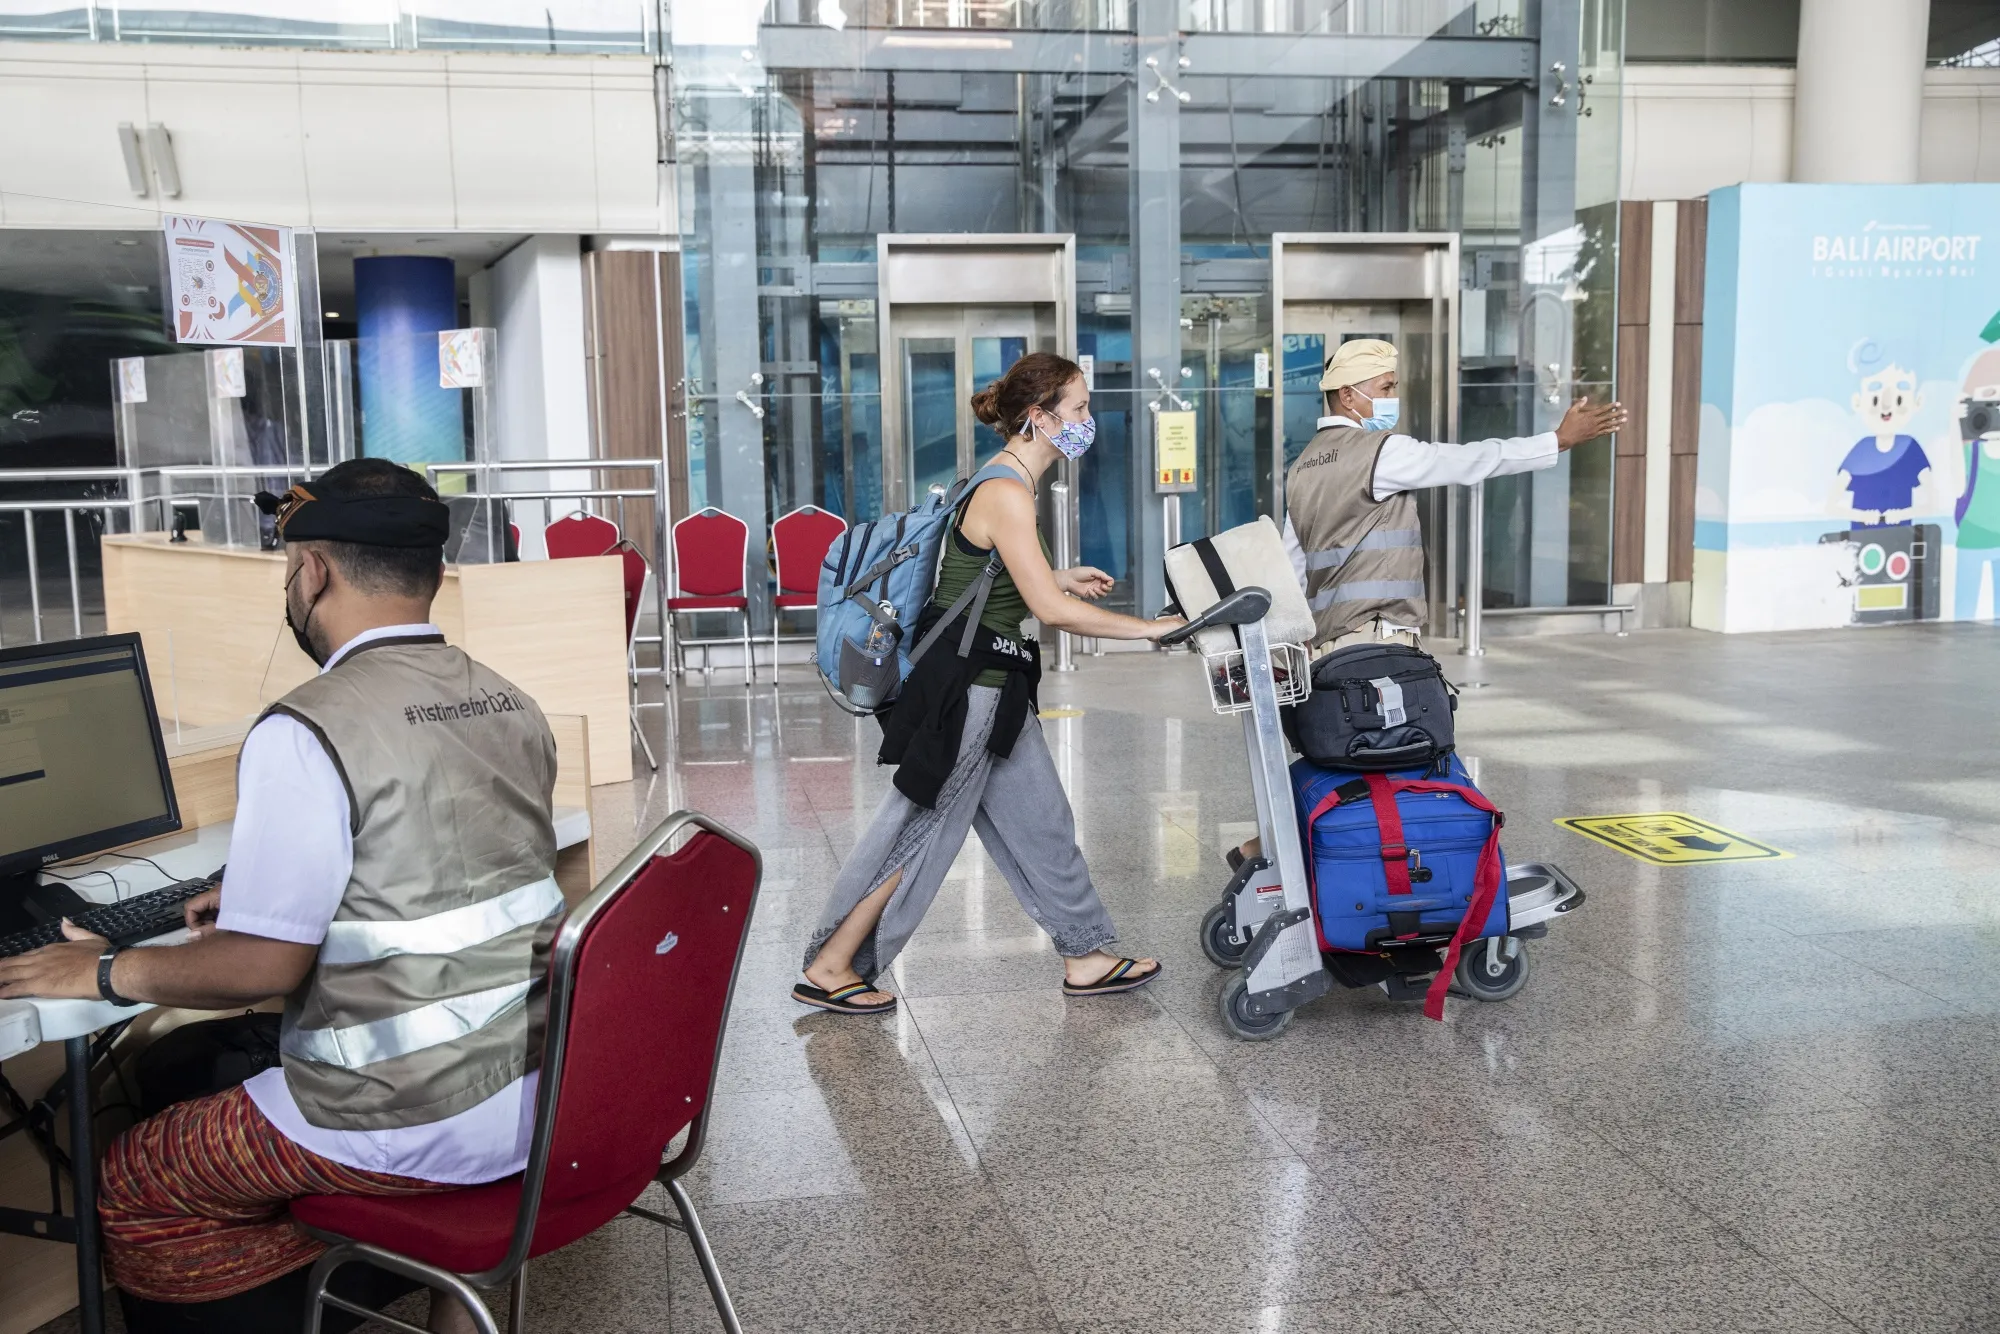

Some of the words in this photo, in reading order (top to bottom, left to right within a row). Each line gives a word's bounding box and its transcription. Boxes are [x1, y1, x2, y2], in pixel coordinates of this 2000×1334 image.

[1813, 235, 1870, 262] BALI
[1874, 235, 1982, 262] AIRPORT
[41, 853, 60, 863] DELL
